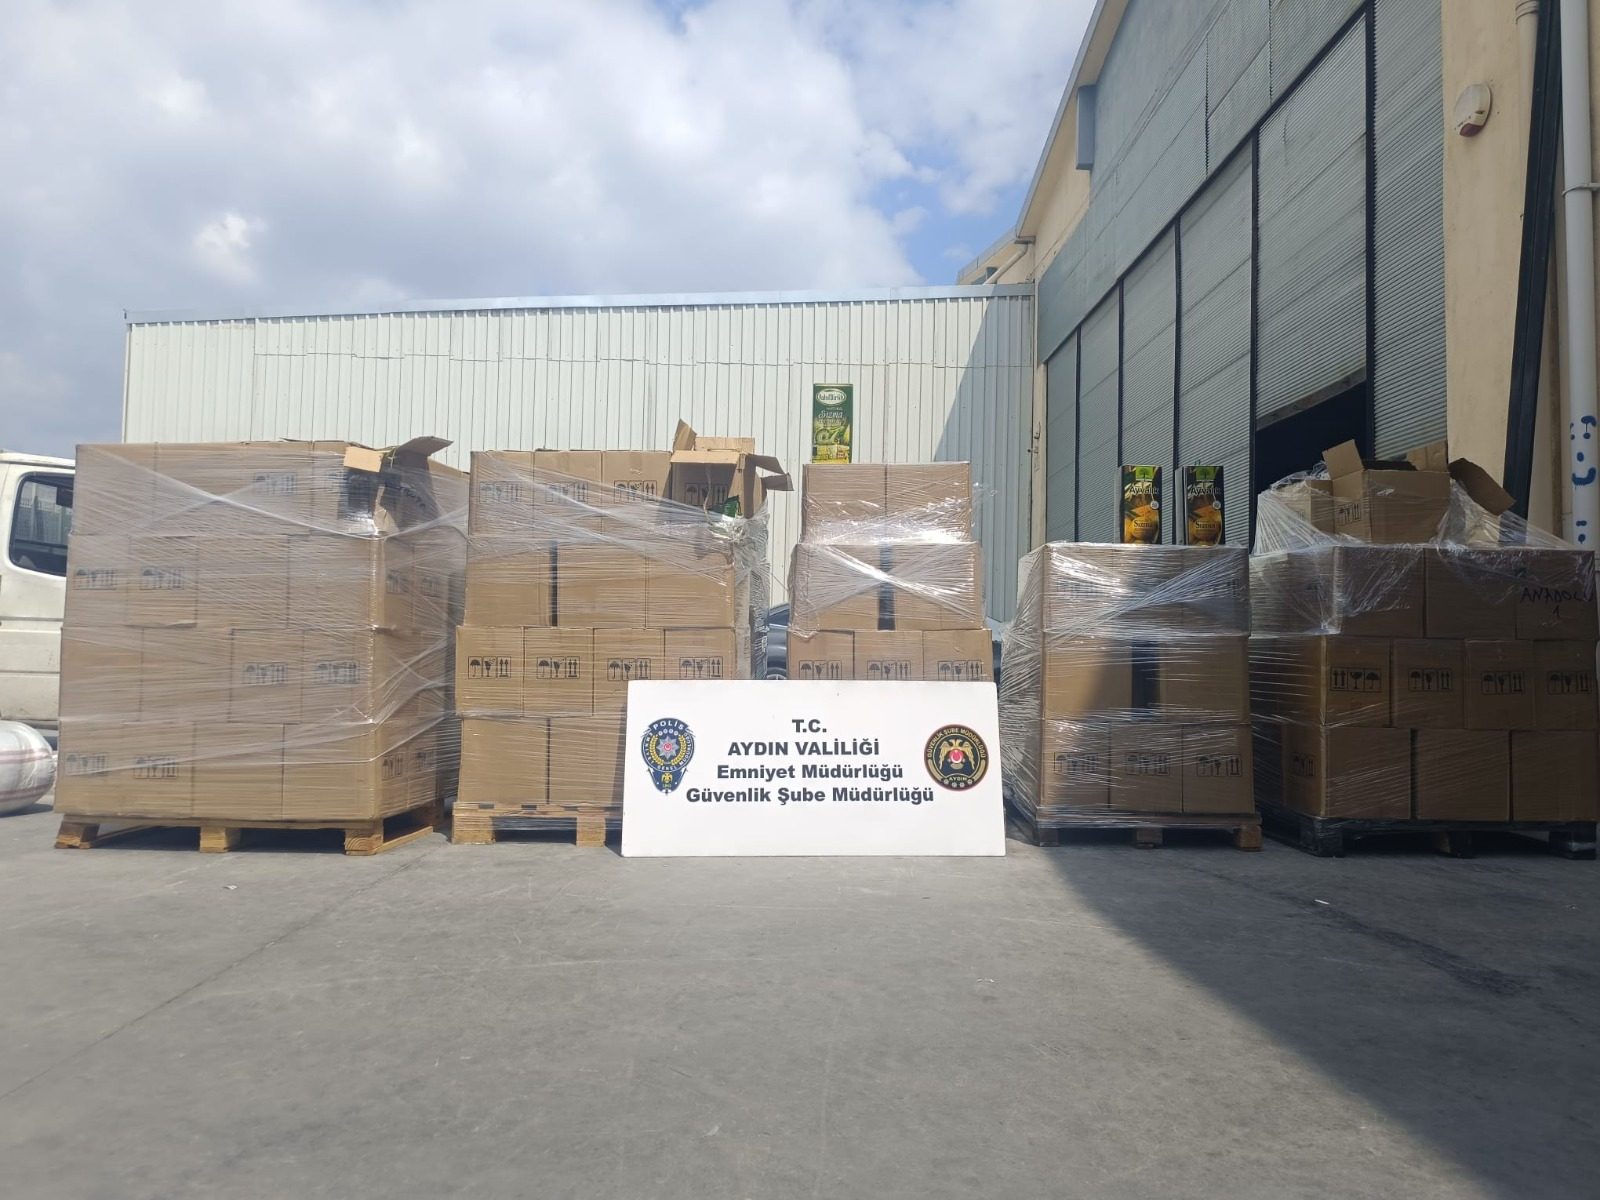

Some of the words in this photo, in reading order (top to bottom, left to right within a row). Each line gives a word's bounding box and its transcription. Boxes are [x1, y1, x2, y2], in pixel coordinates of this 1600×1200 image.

[792, 719, 826, 732] T.C.
[728, 742, 788, 755] AYDIN
[795, 739, 878, 755] VALİLİĞİ
[718, 765, 795, 782] Emniyet
[802, 765, 902, 781] Müdürlüğü
[687, 788, 771, 802] Güvenlik
[778, 788, 825, 805] Şube
[833, 788, 933, 805] Müdürlüğü
